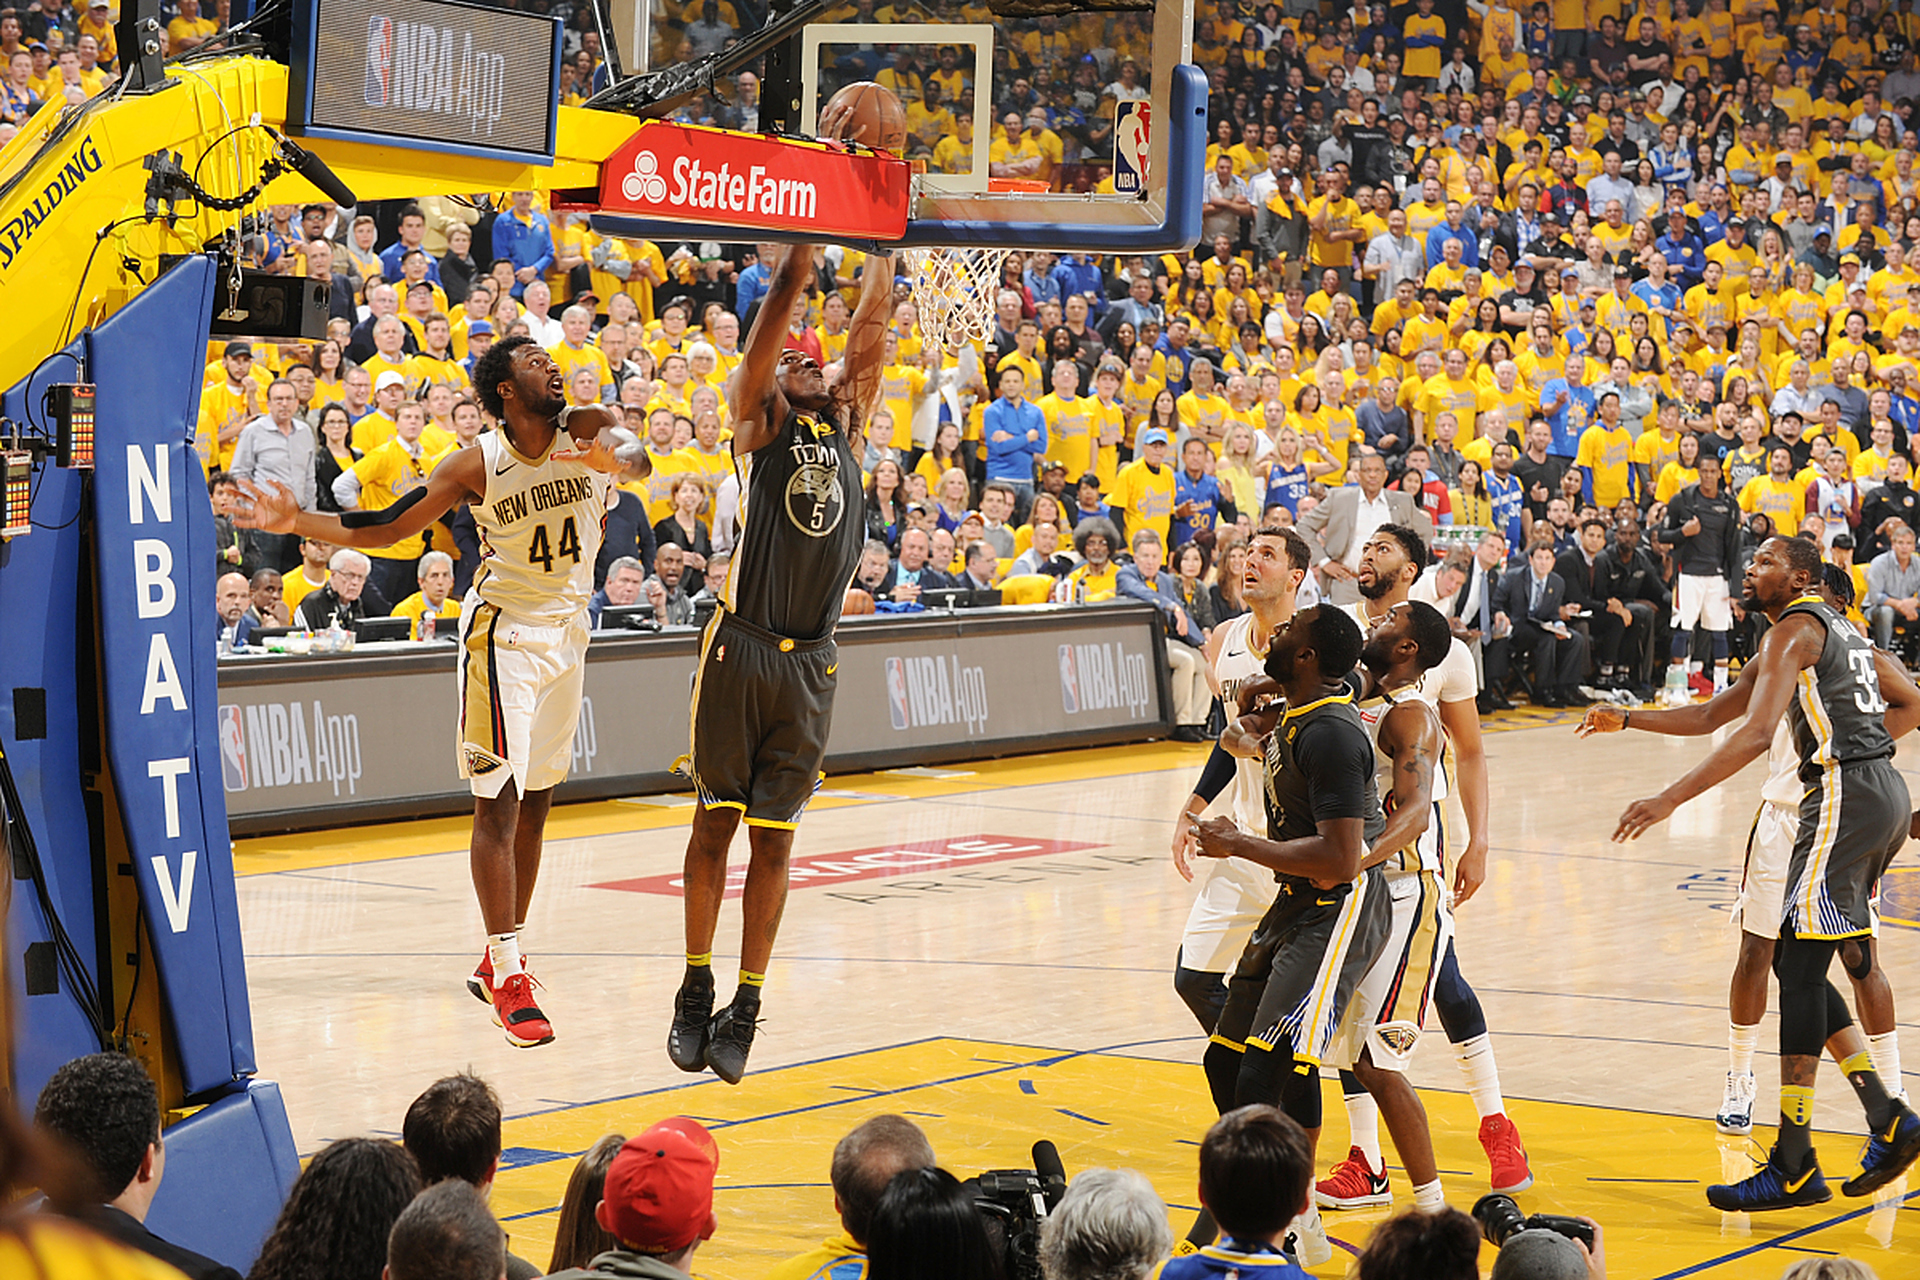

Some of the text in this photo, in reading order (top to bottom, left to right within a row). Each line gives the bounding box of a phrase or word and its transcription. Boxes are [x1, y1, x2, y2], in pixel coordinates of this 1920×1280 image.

[393, 21, 505, 136] NBA App
[1118, 172, 1136, 188] NBA
[492, 475, 593, 528] NEW ORLEANS
[810, 503, 826, 529] 5
[1189, 512, 1211, 529] 30
[1288, 484, 1307, 499] 35
[528, 515, 582, 573] 44
[126, 443, 197, 933] NBA TV
[904, 654, 988, 735] NBA App
[1075, 641, 1149, 719] NBA App
[1848, 648, 1886, 713] 35
[245, 700, 362, 797] NBA App
[572, 696, 597, 774] pp
[824, 854, 1173, 905] ARENA
